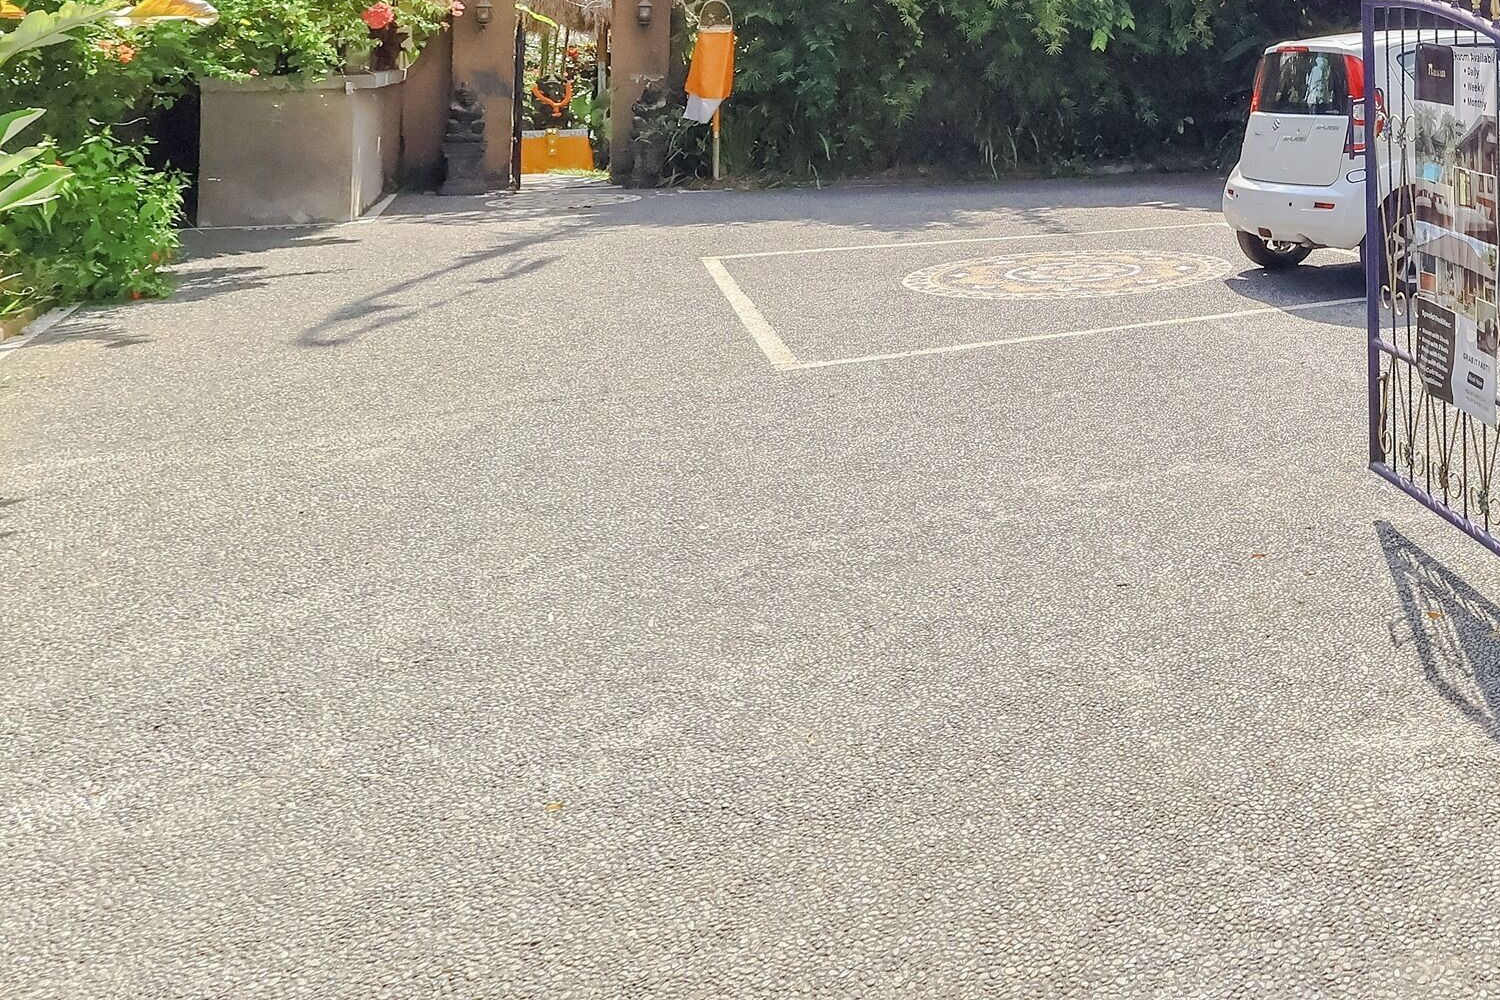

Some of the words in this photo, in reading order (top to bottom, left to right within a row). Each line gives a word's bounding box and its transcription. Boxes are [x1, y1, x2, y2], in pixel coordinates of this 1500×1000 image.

[1467, 67, 1480, 79] Daily
[1467, 83, 1485, 95] Weekly
[1467, 97, 1487, 111] Monthly
